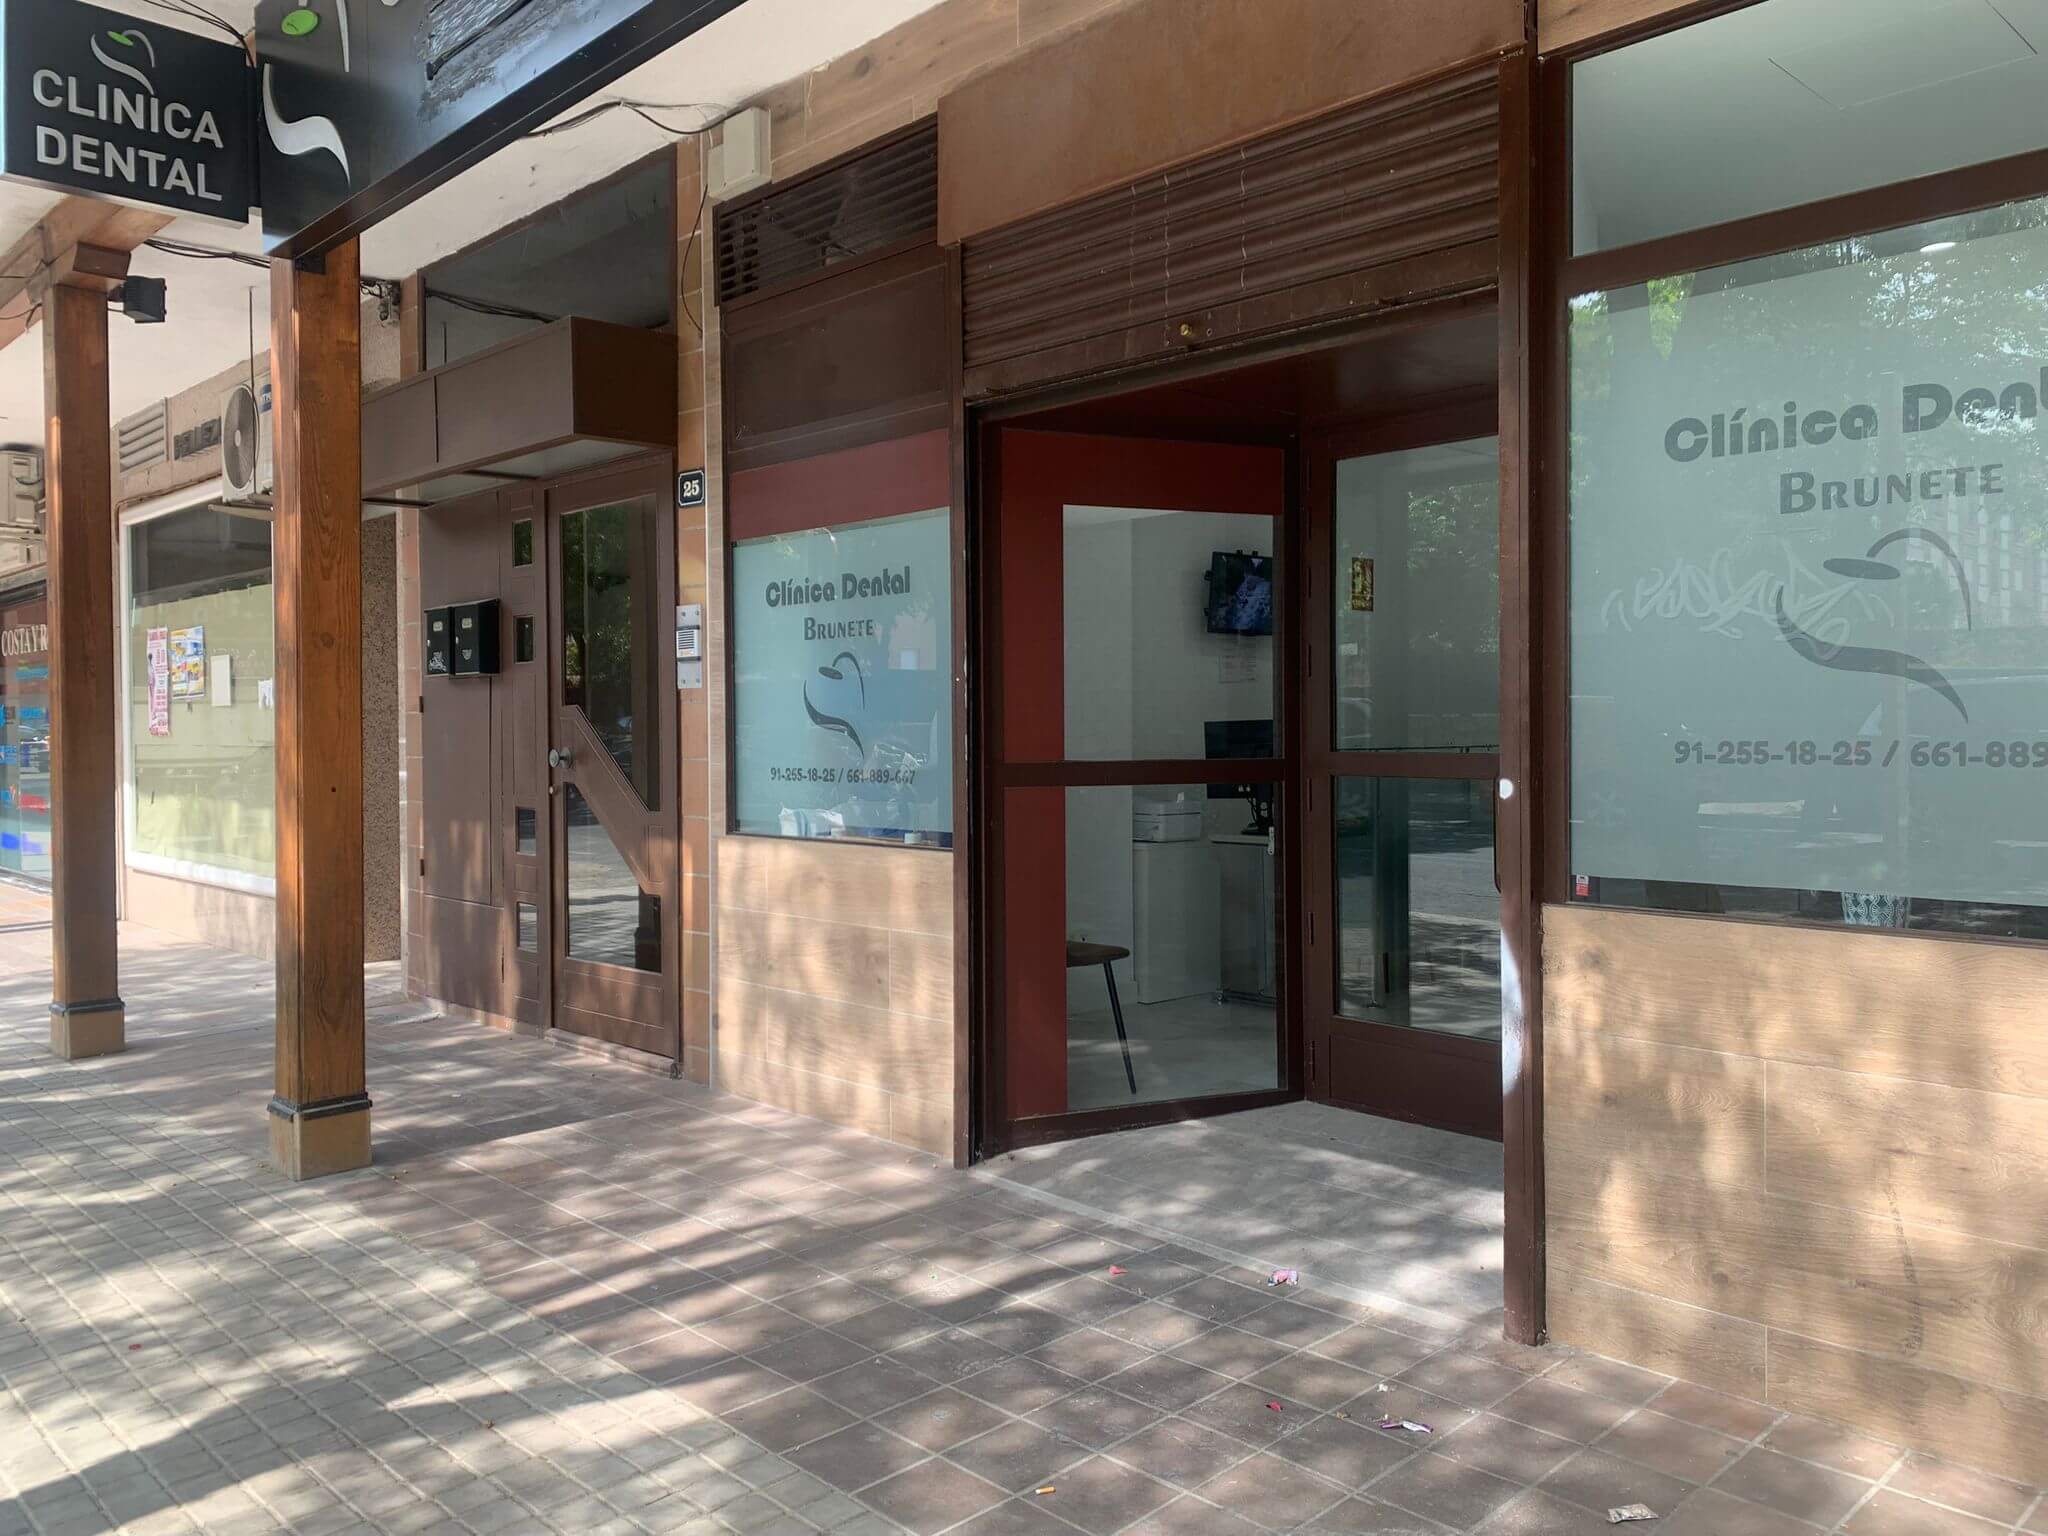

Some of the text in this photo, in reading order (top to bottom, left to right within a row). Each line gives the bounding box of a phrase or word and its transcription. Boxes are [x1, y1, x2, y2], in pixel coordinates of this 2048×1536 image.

[33, 69, 224, 148] CLINICA
[36, 126, 223, 201] DENTAL
[1664, 401, 1879, 463] Clínica
[683, 480, 700, 497] 25
[1780, 464, 2003, 514] BRUNETE
[766, 566, 910, 607] Clínica Dental
[804, 617, 874, 640] BRUNETE
[1674, 740, 1872, 766] 91-255-18-25
[770, 767, 835, 782] 91-255-18-25
